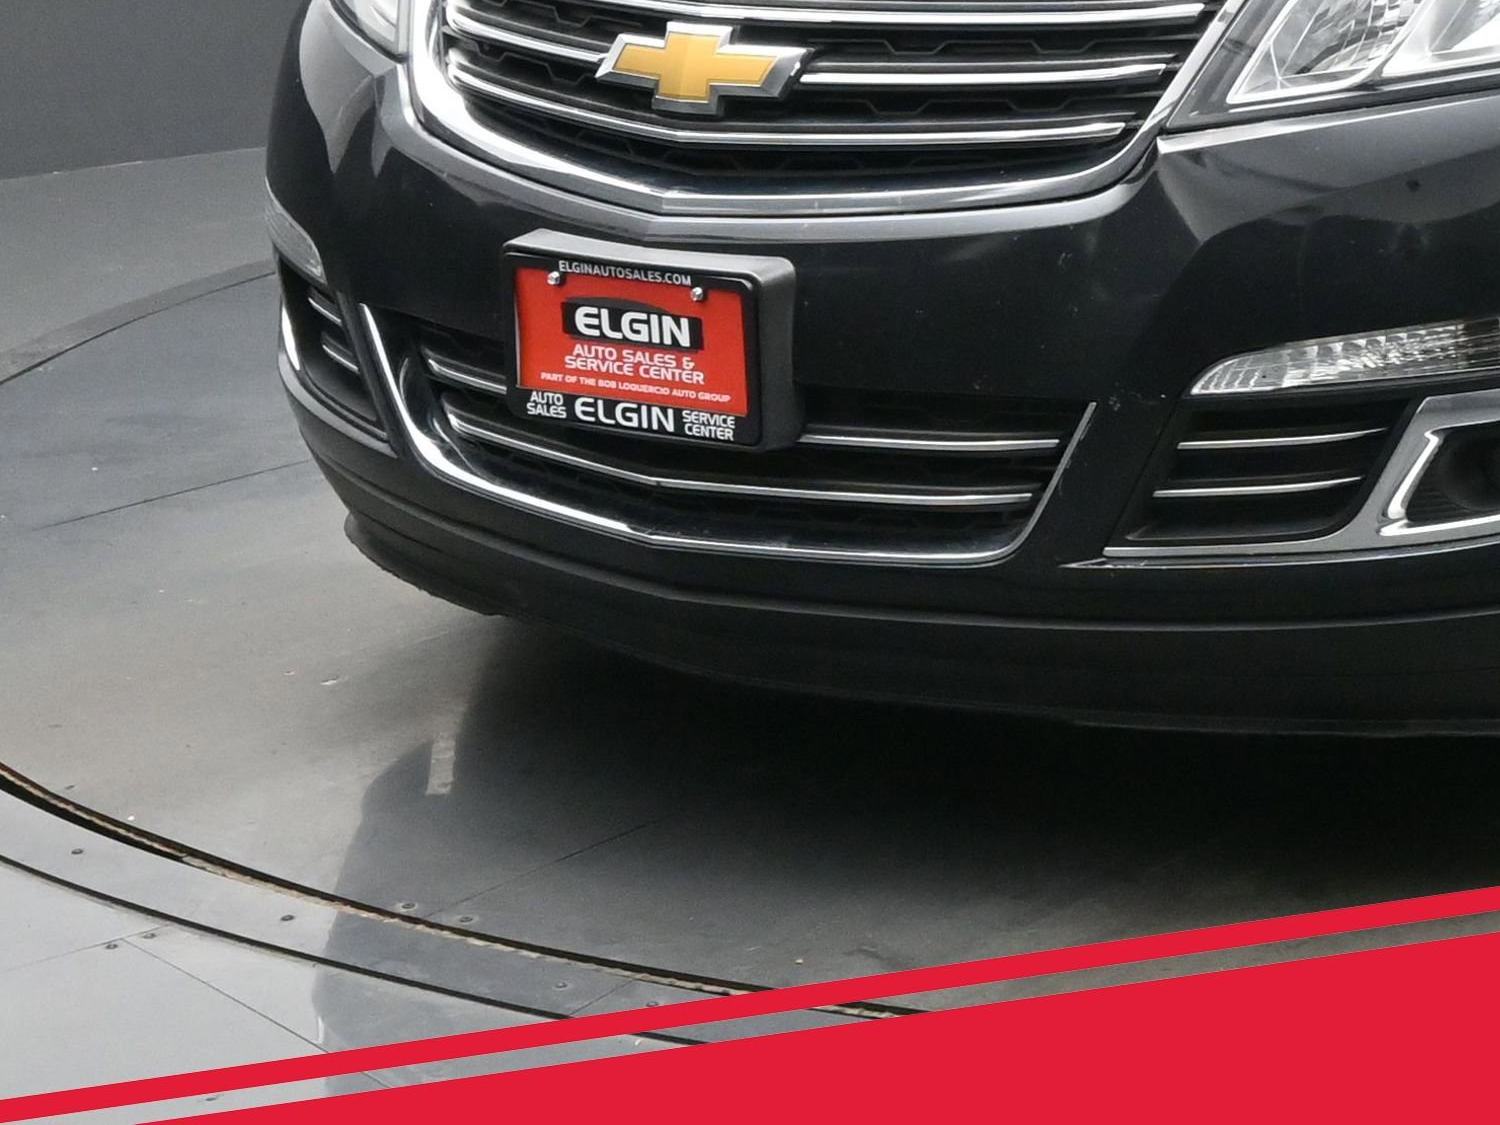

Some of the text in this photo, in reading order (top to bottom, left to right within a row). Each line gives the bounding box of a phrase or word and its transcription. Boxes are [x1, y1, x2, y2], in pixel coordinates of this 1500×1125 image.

[558, 260, 692, 286] ELGINAUTOSALES.COM
[574, 306, 691, 348] ELGIN
[564, 355, 705, 385] SERVICE CENTER
[572, 343, 696, 371] AUTO SALES &
[529, 390, 564, 406] AUTO
[540, 372, 563, 383] PART
[565, 374, 578, 384] OF
[579, 376, 597, 387] THE
[671, 388, 697, 399] AUTO
[697, 391, 732, 403] GROUP
[526, 402, 567, 419] SALES
[574, 396, 675, 433] ELGIN
[681, 409, 736, 429] SERVICE
[684, 423, 735, 442] CENTER
